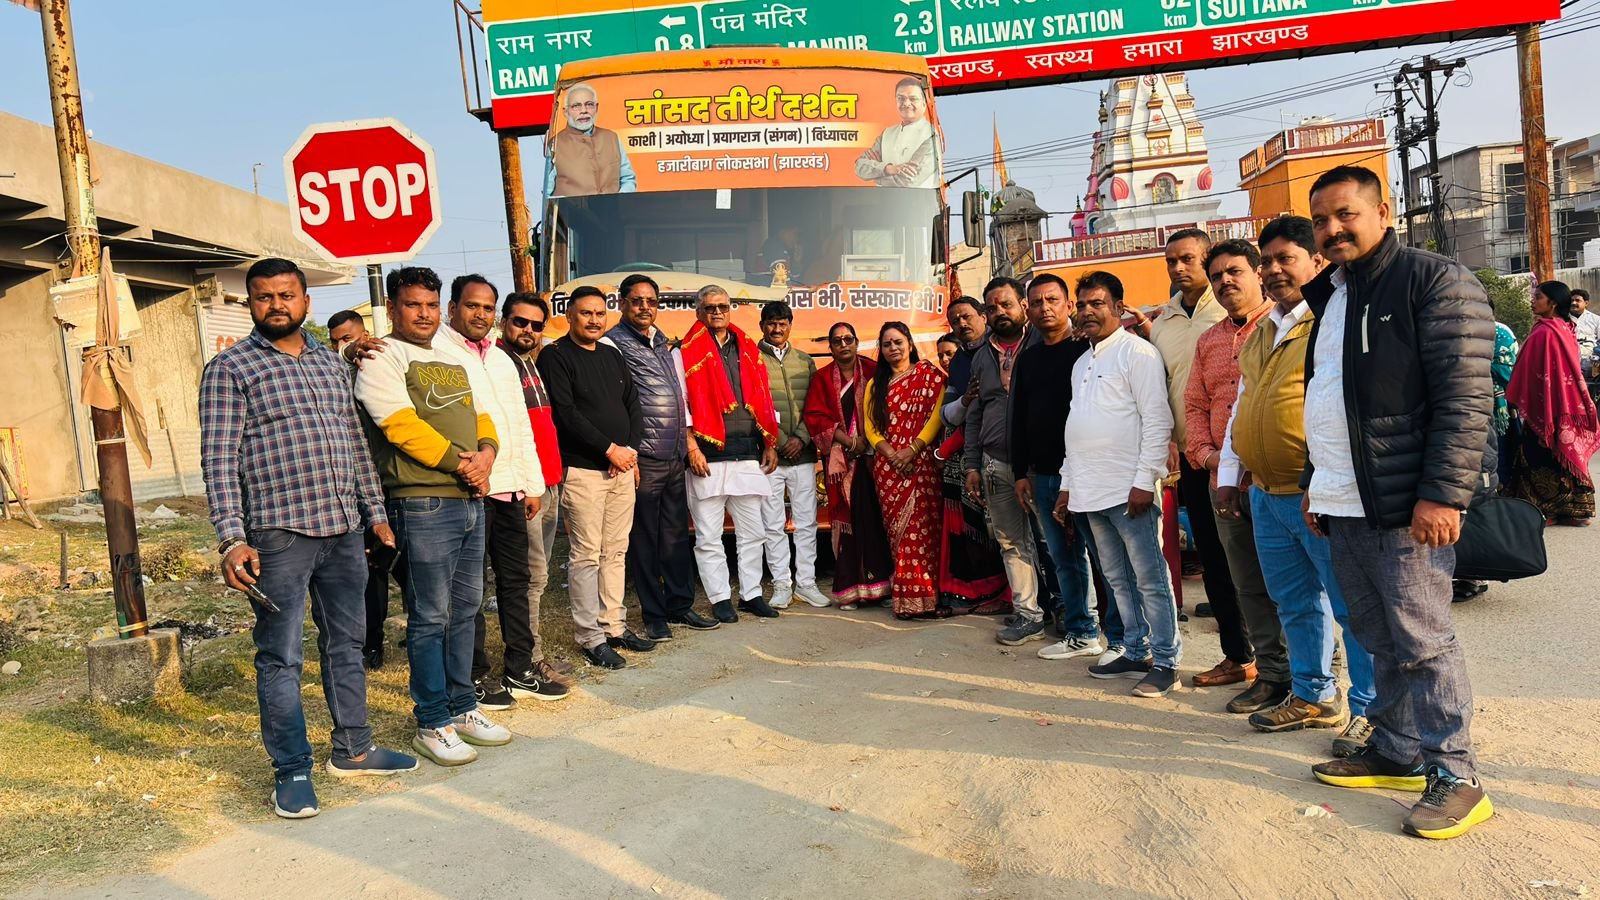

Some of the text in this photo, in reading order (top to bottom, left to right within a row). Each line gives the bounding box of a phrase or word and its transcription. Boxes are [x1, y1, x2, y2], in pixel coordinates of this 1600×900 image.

[711, 4, 807, 33] पंच मंदिर
[893, 10, 934, 37] 2.3
[950, 8, 1124, 47] RAILWAY STATION
[1163, 13, 1187, 27] km
[496, 30, 593, 54] राम नगर
[904, 40, 927, 54] km
[1122, 39, 1183, 62] हमारा
[1210, 24, 1309, 51] झारखण्ड
[498, 64, 548, 90] RAM
[625, 85, 858, 125] सांसद तीर्थ दर्शन
[628, 126, 859, 147] काशी अयोध्या प्रयागराज (संगम) विंध्याचल
[656, 152, 830, 173] हजारीबाग लोकसभा (झारखंड)
[299, 162, 427, 226] STOP
[849, 283, 911, 309] संस्कार
[416, 366, 470, 388] NIKE
